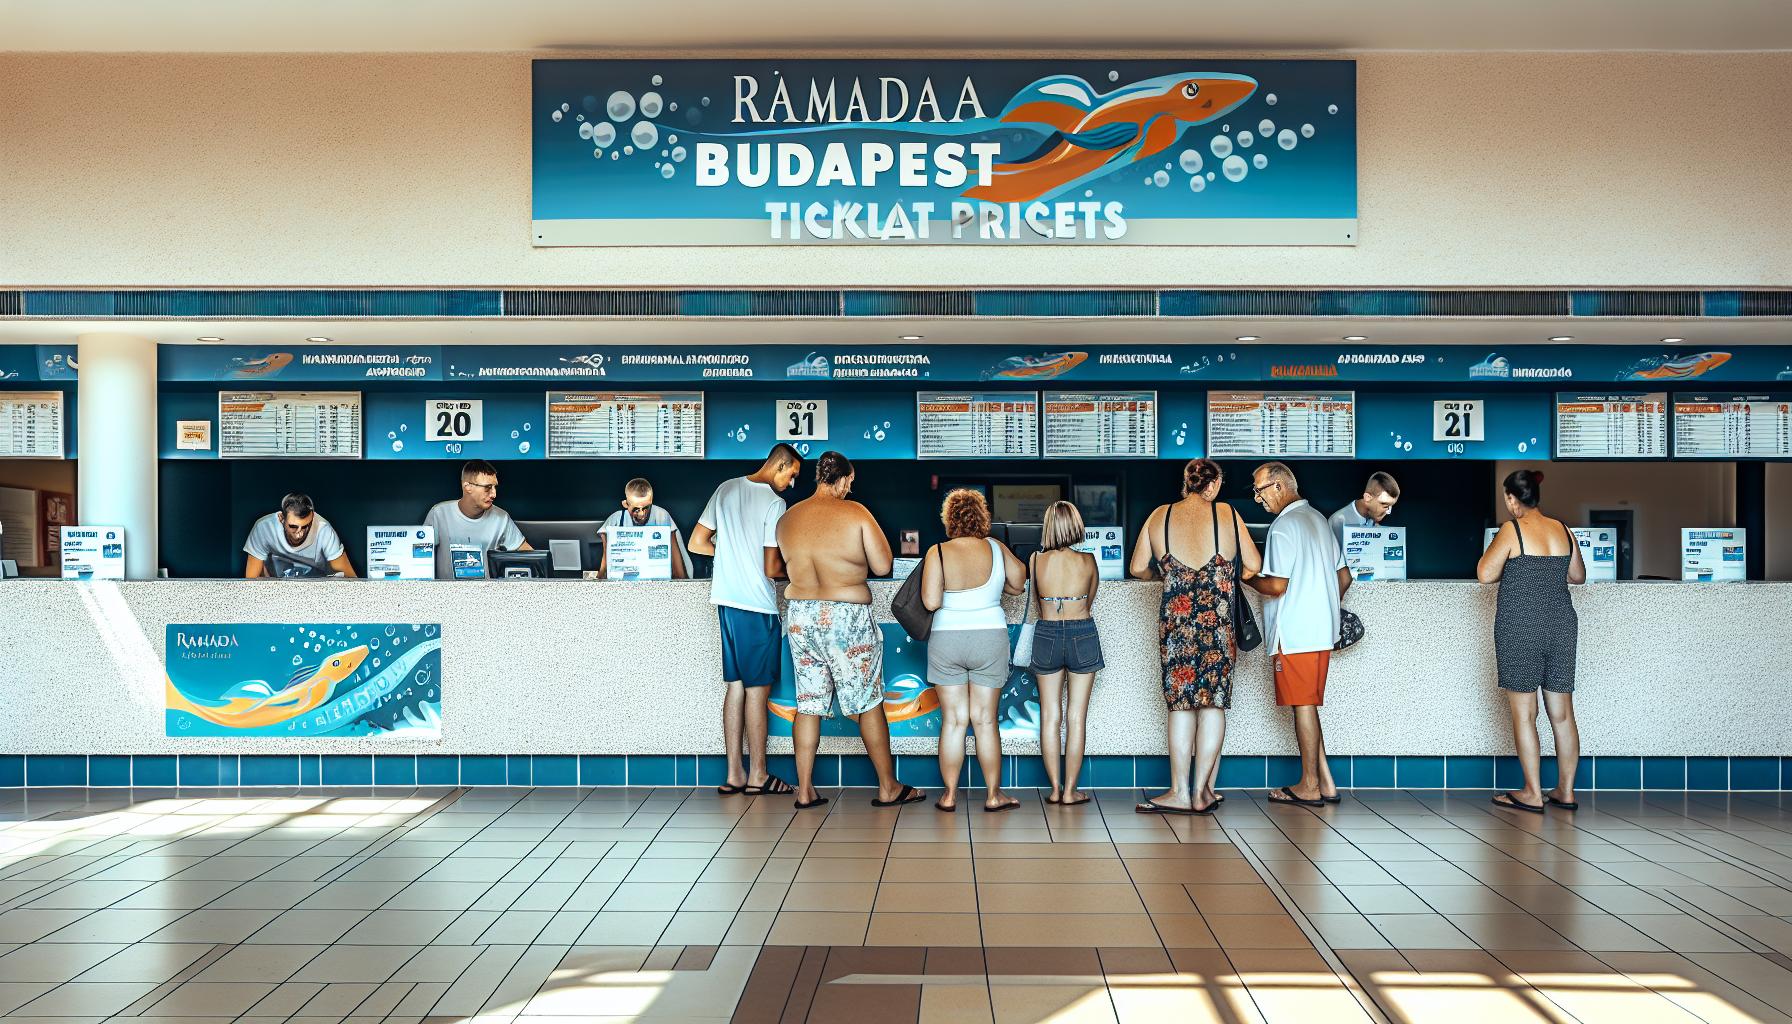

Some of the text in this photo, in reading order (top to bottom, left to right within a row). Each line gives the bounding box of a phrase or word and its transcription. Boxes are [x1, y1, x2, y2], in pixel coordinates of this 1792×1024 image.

[731, 75, 988, 123] RAMADAA
[696, 142, 1001, 188] BUDAPEST
[765, 201, 1128, 240] TICKLAT PRICETS
[437, 411, 471, 437] 20
[1445, 412, 1470, 437] 21
